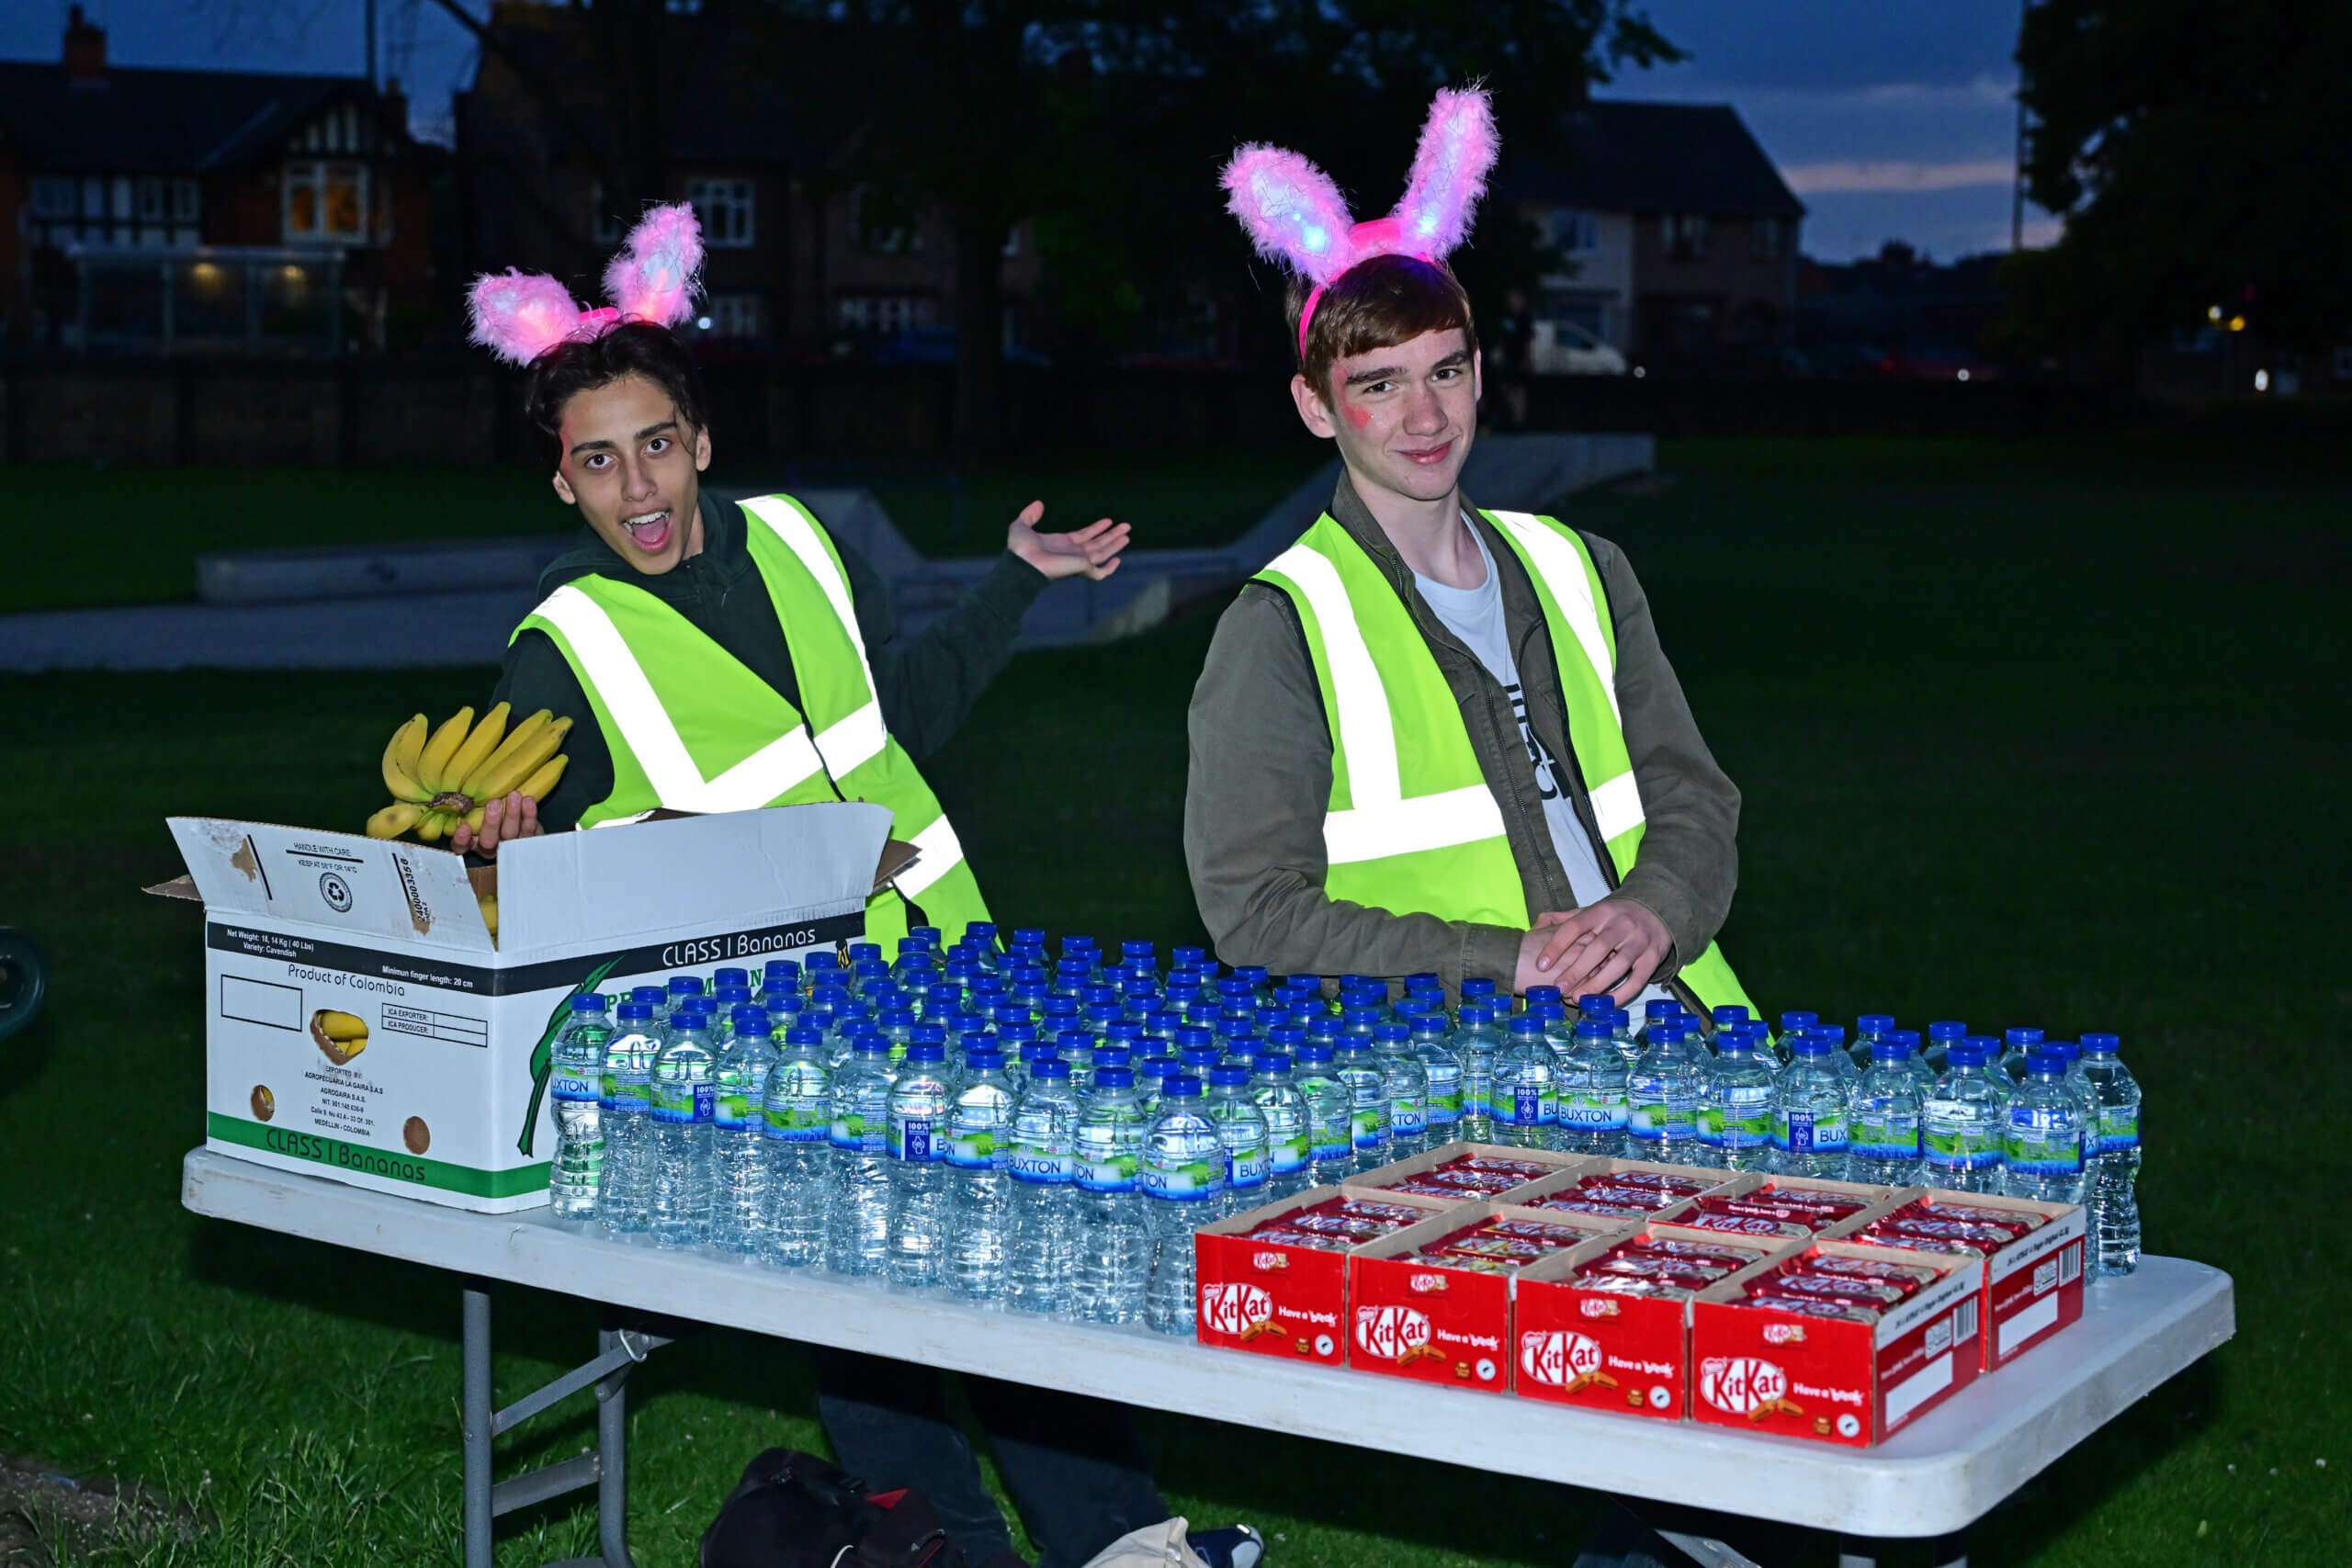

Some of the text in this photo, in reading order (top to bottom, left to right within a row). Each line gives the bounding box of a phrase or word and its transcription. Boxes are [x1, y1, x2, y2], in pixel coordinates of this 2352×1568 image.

[227, 929, 237, 938] Net
[238, 931, 259, 942] Weight:
[279, 938, 288, 948] Kg
[243, 942, 297, 958] Variety: Cavendish
[662, 939, 721, 966] CLASS
[738, 929, 816, 955] Bananas
[288, 964, 405, 997] Product of Colombia
[410, 970, 429, 982] finger
[430, 974, 452, 986] length:
[462, 980, 473, 988] cm
[388, 1008, 397, 1016] ICA
[388, 1021, 397, 1029] ICA
[1517, 1088, 1537, 1096] 100%
[1561, 1106, 1612, 1122] BUXTON
[908, 1122, 929, 1131] 100%
[266, 1129, 322, 1159] CLASS
[338, 1145, 425, 1181] Bananas
[1009, 1155, 1060, 1174] BUXTON
[1210, 1285, 1268, 1332] KitKat
[1279, 1305, 1301, 1319] Have
[1364, 1308, 1425, 1357] KitKat
[1437, 1329, 1461, 1343] Have
[1532, 1333, 1596, 1383] KitKat
[1609, 1355, 1634, 1370] Have
[1713, 1359, 1780, 1411] KitKat
[1793, 1382, 1821, 1398] Have
